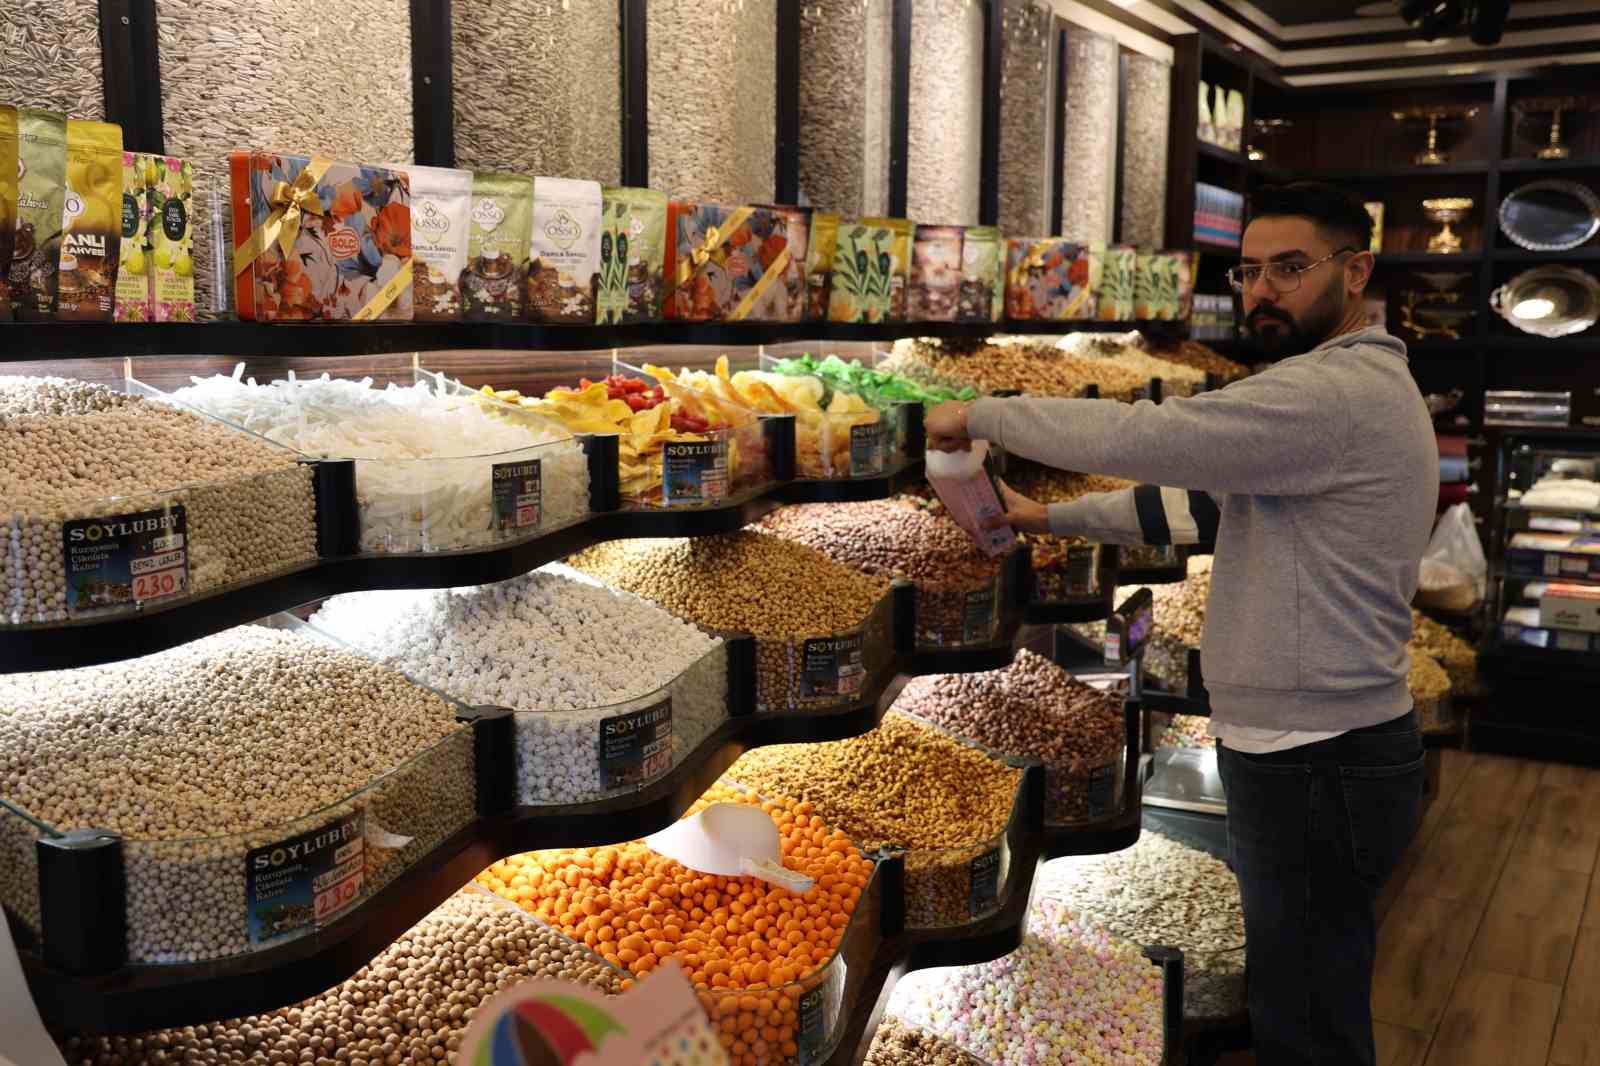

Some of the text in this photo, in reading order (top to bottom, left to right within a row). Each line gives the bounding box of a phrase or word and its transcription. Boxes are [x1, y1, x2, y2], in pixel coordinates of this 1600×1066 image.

[69, 513, 180, 542] SOYLUBEY
[135, 573, 176, 598] 230
[255, 818, 362, 870] SOYLUBEY
